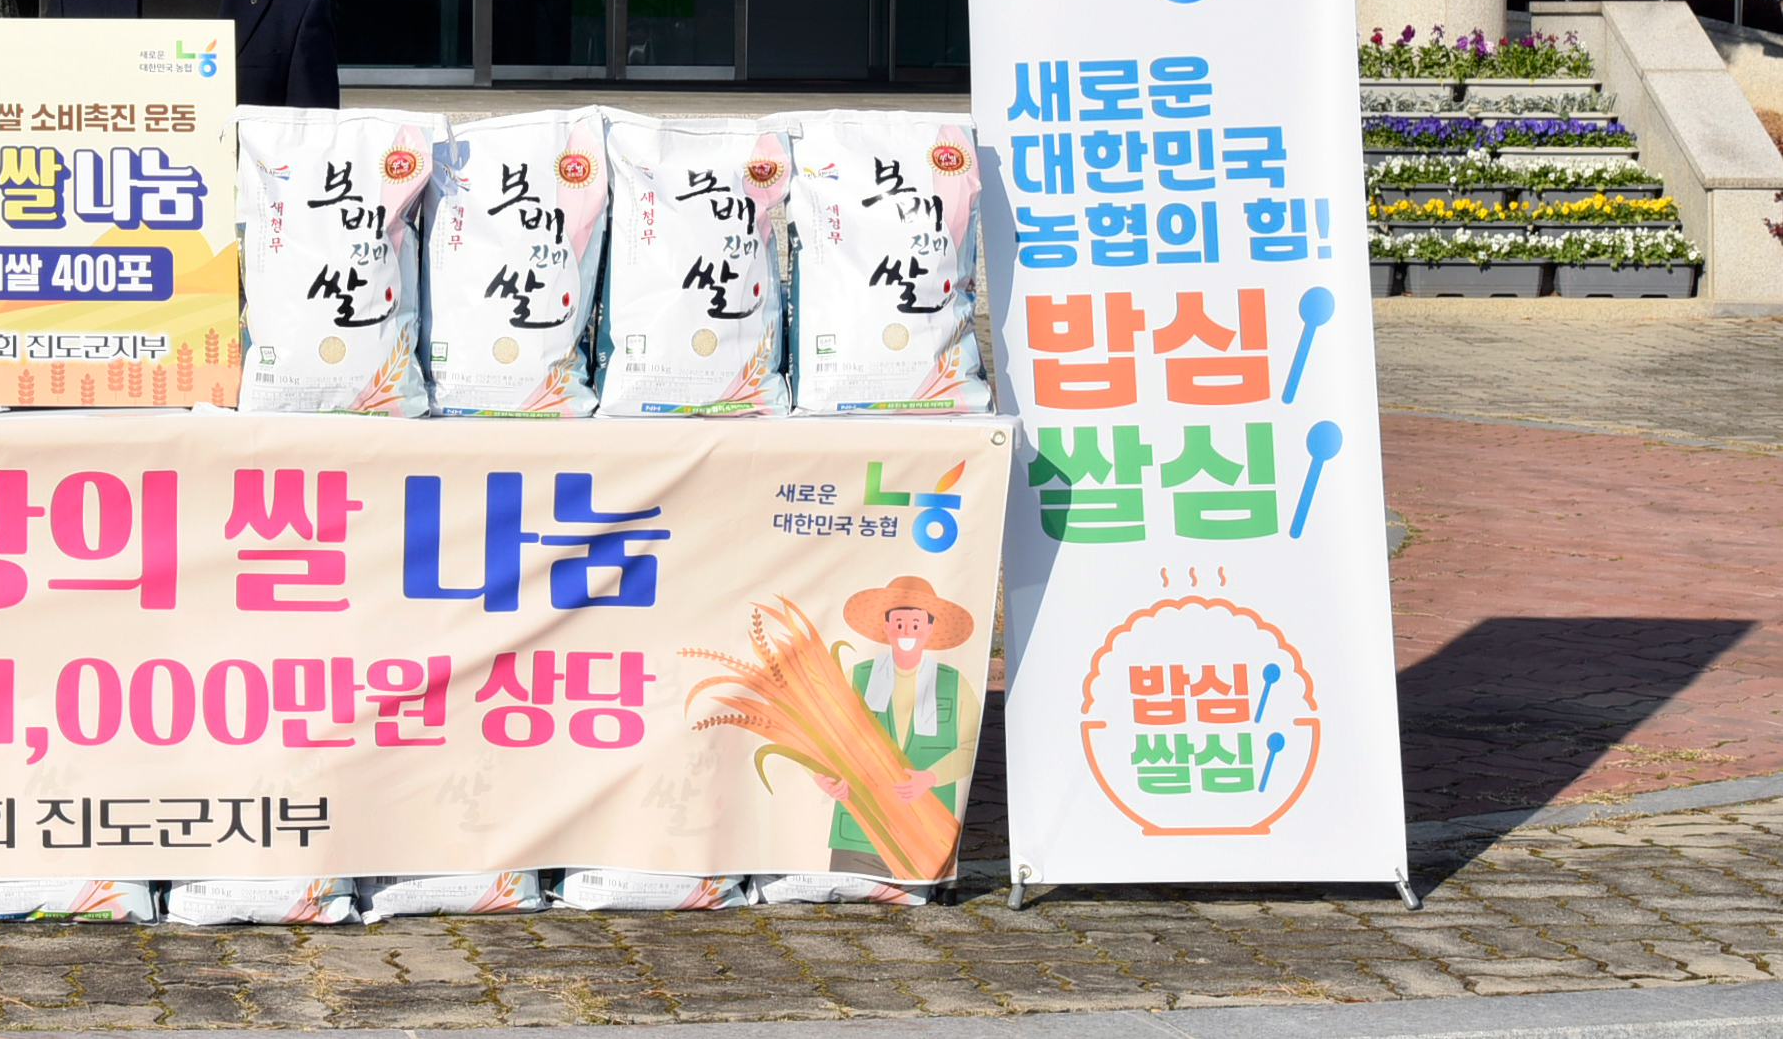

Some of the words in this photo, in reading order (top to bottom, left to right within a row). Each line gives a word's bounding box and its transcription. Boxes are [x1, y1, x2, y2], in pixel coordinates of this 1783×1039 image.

[31, 104, 135, 132] 소비촉진
[145, 105, 196, 132] 운동
[1008, 57, 1212, 121] 새로운
[74, 147, 207, 229] 나눔
[1011, 126, 1287, 195] 대한민국
[307, 161, 386, 239] 보배
[487, 163, 565, 244] 보배
[350, 242, 388, 265] 진미
[529, 245, 568, 269] 진미
[723, 235, 758, 259] 진미
[910, 232, 948, 256] 진미
[1015, 201, 1219, 269] 농협의
[1243, 197, 1332, 263] 힘!
[52, 253, 153, 292] 400포
[306, 264, 398, 327] 쌀
[483, 264, 575, 328] 쌀
[682, 256, 763, 319] 쌀
[869, 255, 955, 314] 쌀
[26, 333, 168, 360] 진도군지부
[1026, 289, 1270, 409] 밥심
[776, 484, 836, 504] 새로운
[1027, 422, 1279, 544] 쌀심
[224, 468, 364, 612] 쌀
[403, 471, 671, 612] 나눔
[774, 514, 853, 535] 대한민국
[859, 516, 897, 537] 농협
[475, 650, 657, 749] 상당
[1128, 663, 1250, 726] 밥심
[1130, 732, 1255, 795] 쌀심
[37, 797, 330, 848] 진도군지부
